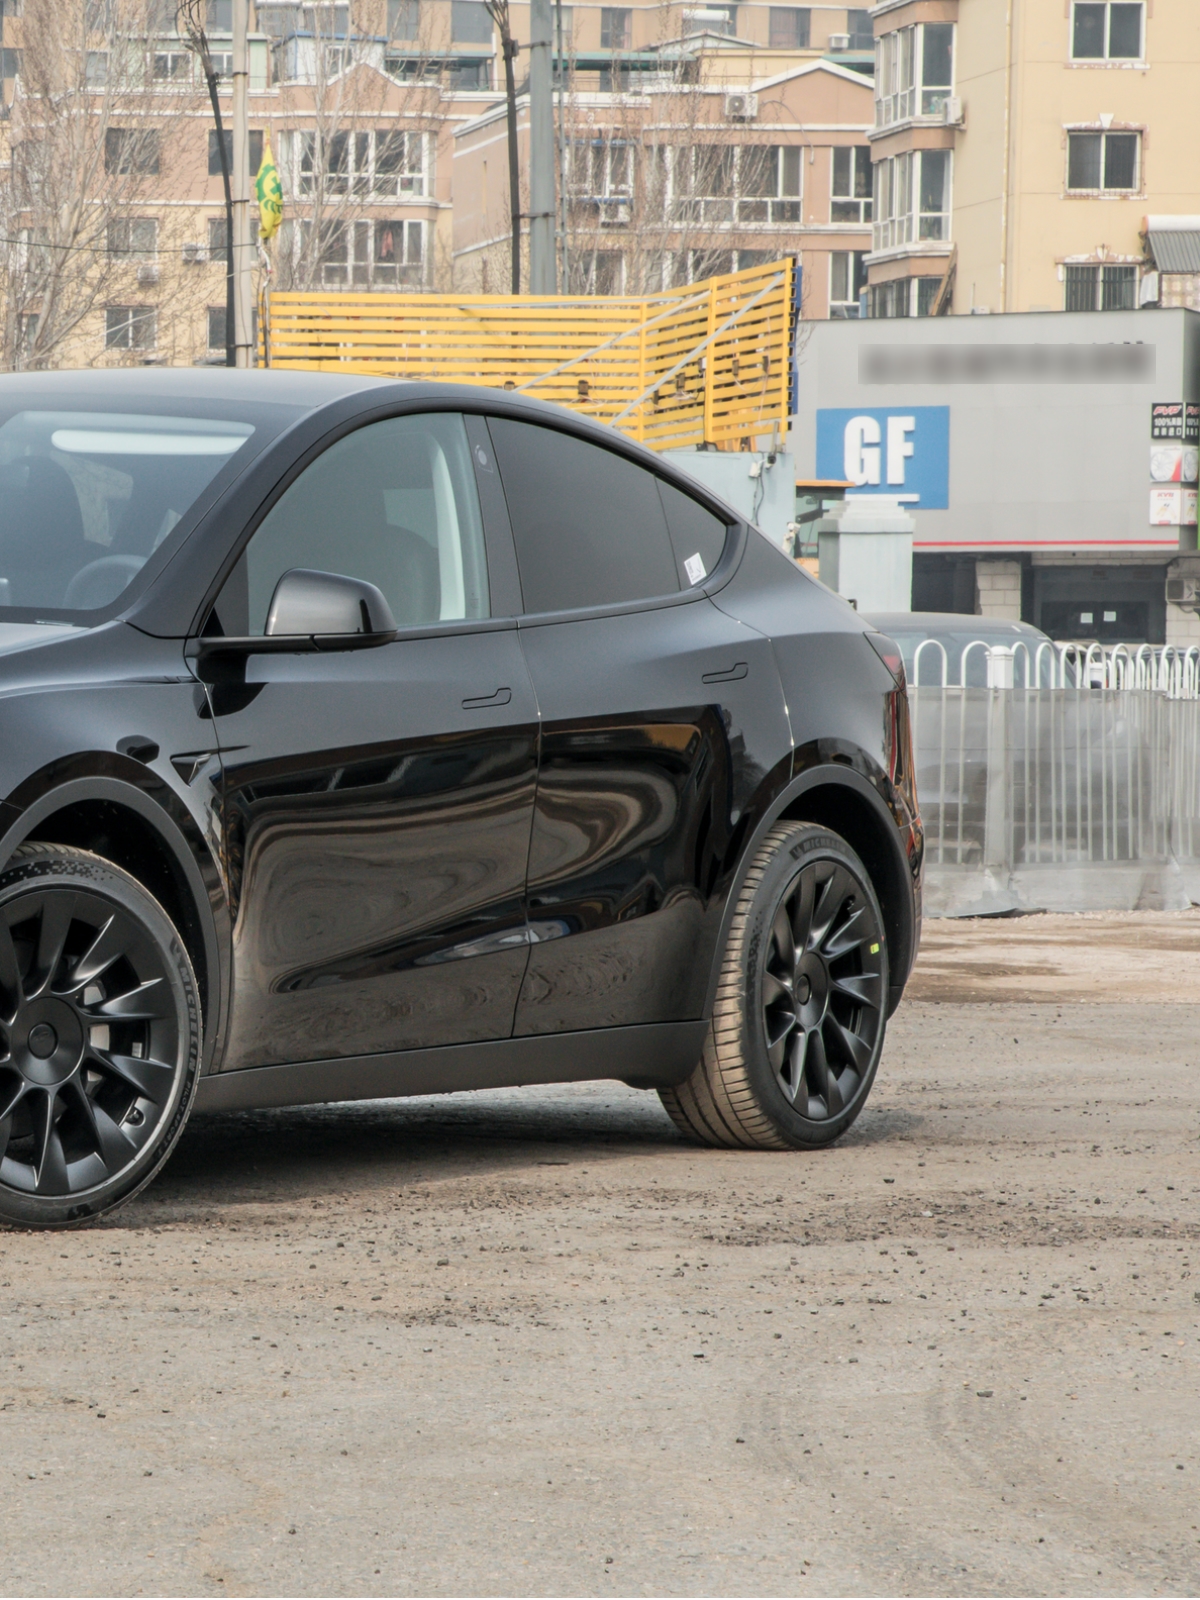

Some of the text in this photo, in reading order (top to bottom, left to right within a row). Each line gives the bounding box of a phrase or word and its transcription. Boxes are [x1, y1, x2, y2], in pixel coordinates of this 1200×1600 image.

[844, 415, 915, 486] GF
[180, 967, 197, 1073] MICHELIN
[179, 1081, 191, 1113] PILOT
